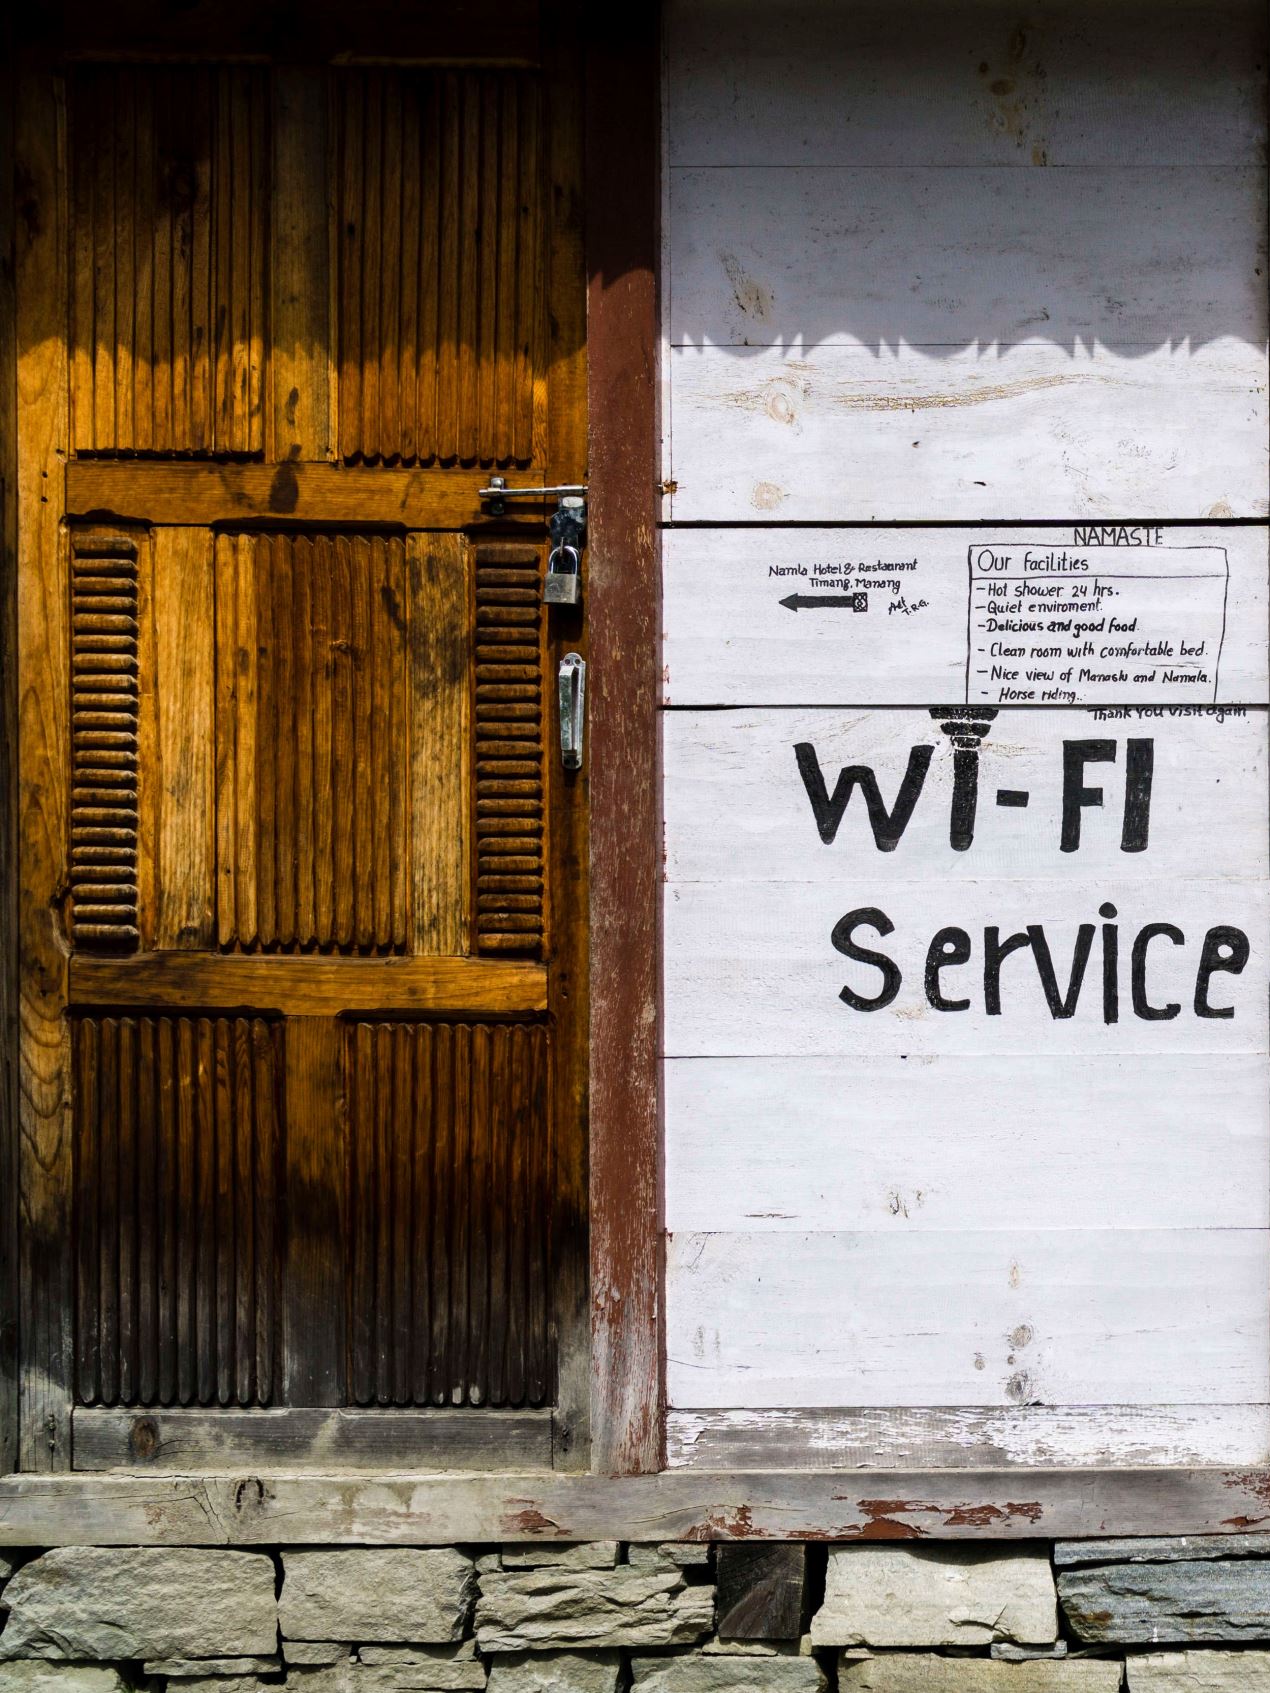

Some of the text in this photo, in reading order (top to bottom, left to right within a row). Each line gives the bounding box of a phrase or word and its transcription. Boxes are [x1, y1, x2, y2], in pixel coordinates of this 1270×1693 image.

[1073, 527, 1164, 546] NAMASTE
[813, 563, 842, 575] Hotel
[843, 562, 856, 575] &
[977, 549, 1012, 572] Our
[855, 577, 901, 594] Manang
[1014, 582, 1065, 597] shower
[1071, 585, 1089, 598] 24
[1092, 578, 1120, 597] hrs.
[1046, 618, 1073, 633] and
[1072, 618, 1105, 638] good
[1030, 647, 1063, 658] room
[1067, 641, 1095, 657] with
[1100, 641, 1174, 658] comfortable
[1179, 640, 1209, 657] bed.
[1025, 669, 1055, 681] view
[1059, 667, 1074, 683] of
[1132, 669, 1156, 684] and
[1087, 705, 1132, 721] Thank
[830, 901, 1250, 1025] Service
